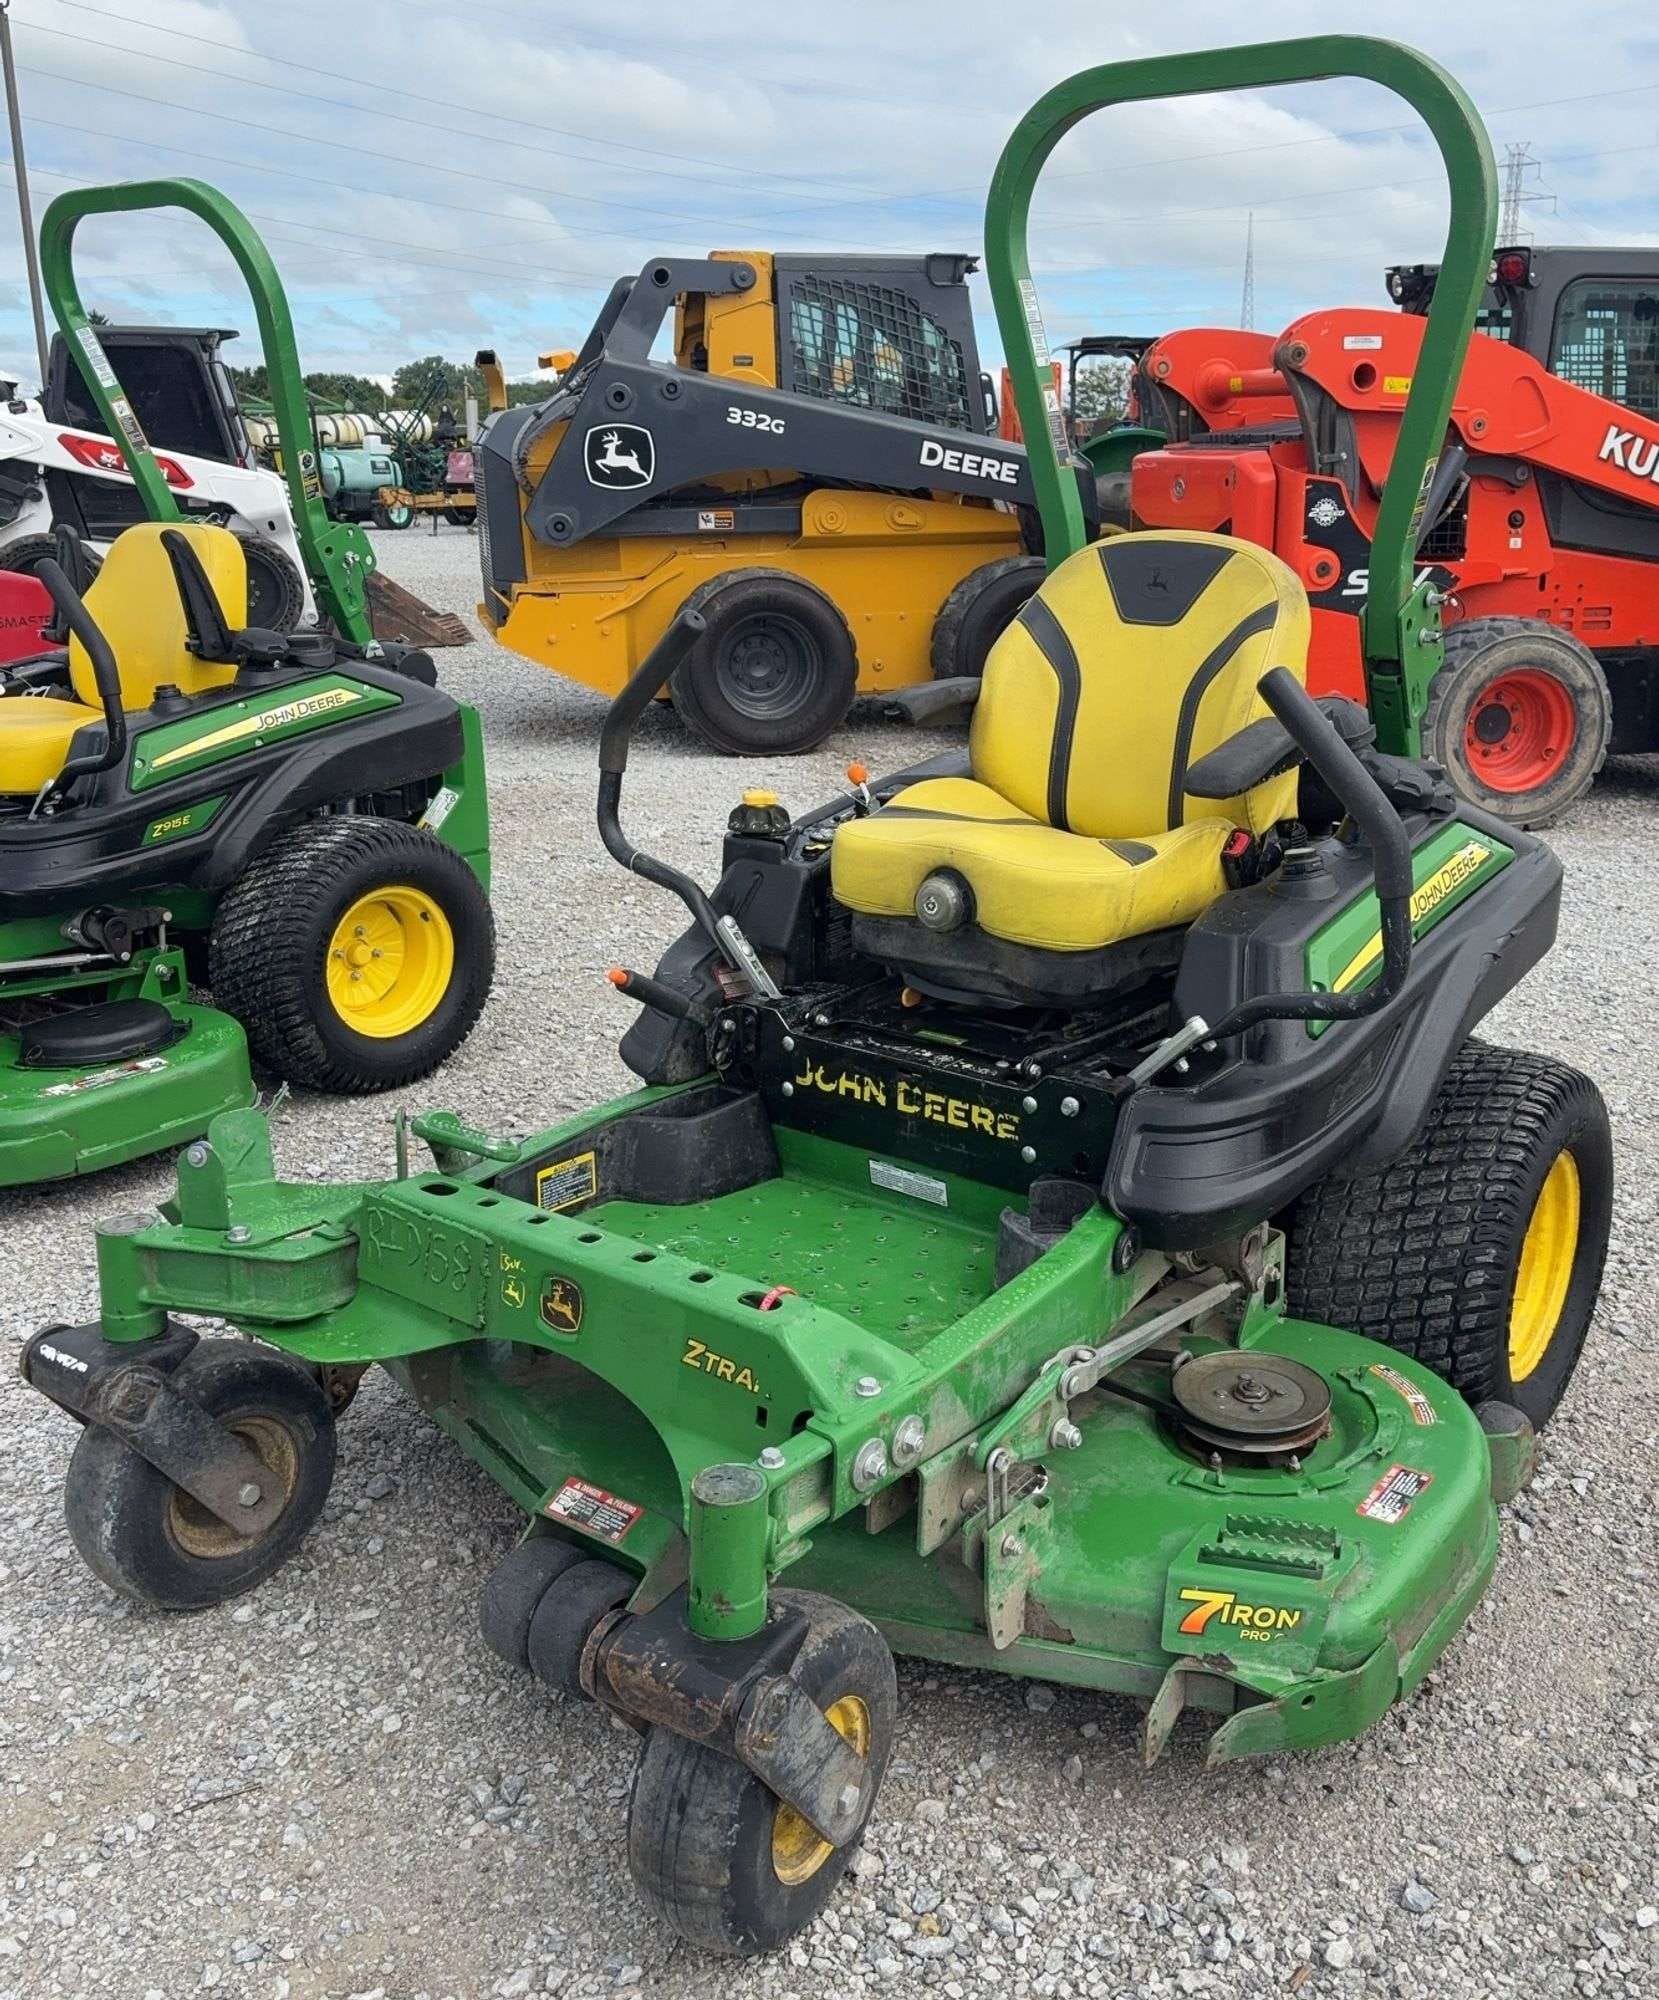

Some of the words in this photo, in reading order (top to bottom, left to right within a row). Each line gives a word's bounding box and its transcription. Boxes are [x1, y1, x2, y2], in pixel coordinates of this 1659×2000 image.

[726, 406, 786, 435] 332G
[919, 439, 1020, 485] DEERE
[1597, 423, 1659, 484] KU
[257, 705, 296, 730] JOHN
[296, 692, 345, 716] DEERE
[152, 814, 192, 838] Z915E
[1412, 880, 1443, 919] JOHN
[1440, 850, 1478, 892] DEERE
[795, 1056, 887, 1107] JOHN
[1239, 1629, 1271, 1642] PRO
